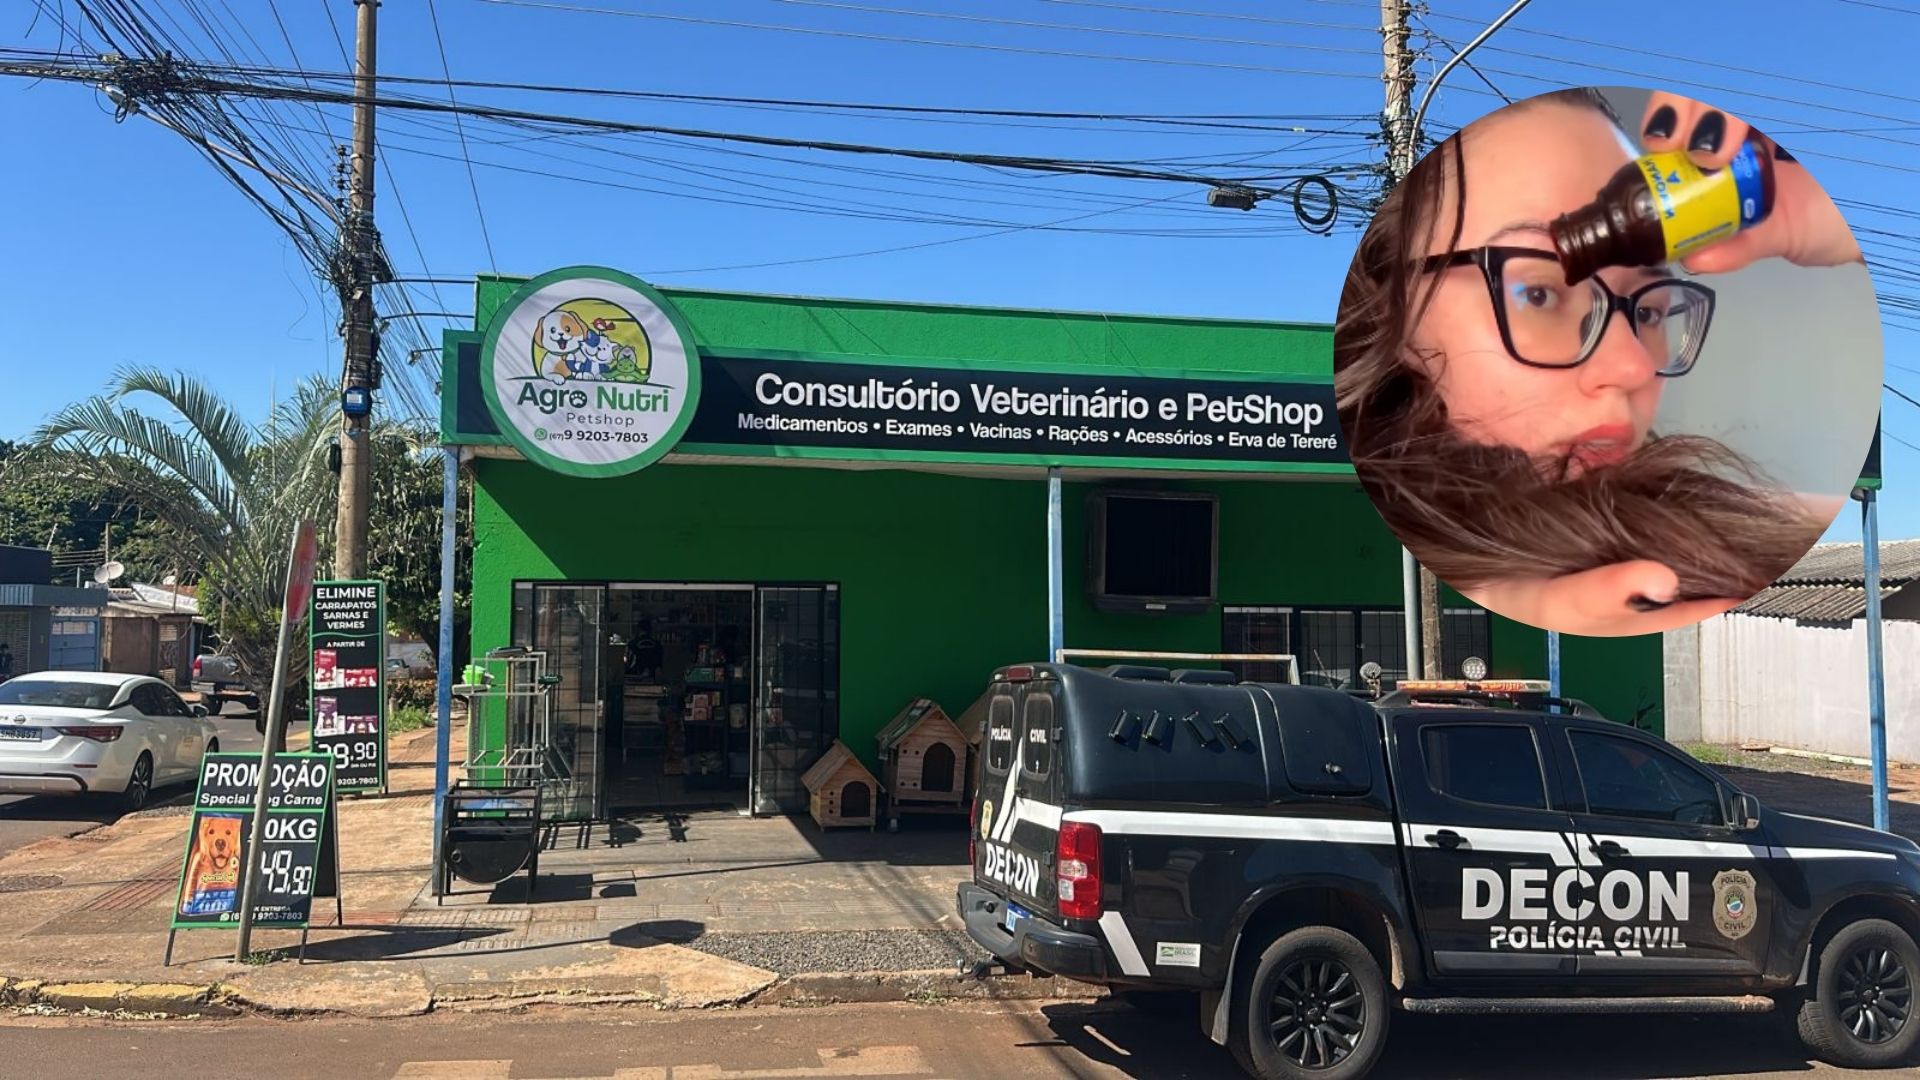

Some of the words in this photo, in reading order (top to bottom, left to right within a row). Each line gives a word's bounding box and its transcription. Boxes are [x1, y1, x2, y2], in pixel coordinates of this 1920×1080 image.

[517, 381, 588, 414] Agro
[596, 386, 669, 412] Nutri
[755, 372, 961, 412] Consultório
[970, 383, 1149, 419] Veterinário
[1158, 398, 1178, 420] e
[1186, 392, 1323, 433] PetShop
[566, 412, 635, 427] Petshop
[576, 430, 648, 443] 9203-7803
[738, 412, 868, 434] Medicamentos
[886, 419, 952, 437] Exames
[970, 422, 1032, 440] Vacinas
[1049, 424, 1109, 445] Rações
[1125, 428, 1213, 446] Acessórios
[1228, 432, 1263, 447] Erva
[1266, 433, 1287, 448] de
[1290, 433, 1337, 449] Tereré
[316, 586, 377, 599] ELIMINE
[315, 601, 377, 610] CARRAPATOS
[323, 611, 361, 620] SARNAS
[362, 611, 369, 619] E
[327, 621, 365, 629] VERMES
[356, 640, 365, 648] DE
[990, 725, 1011, 741] POLÍCIA
[1030, 728, 1047, 744] CIVIL
[200, 793, 250, 807] Special
[284, 794, 323, 805] Carne
[984, 842, 1040, 898] DECON
[1461, 867, 1690, 922] DECON
[1489, 920, 1605, 949] POLÍCIA
[1613, 925, 1687, 949] CIVIL
